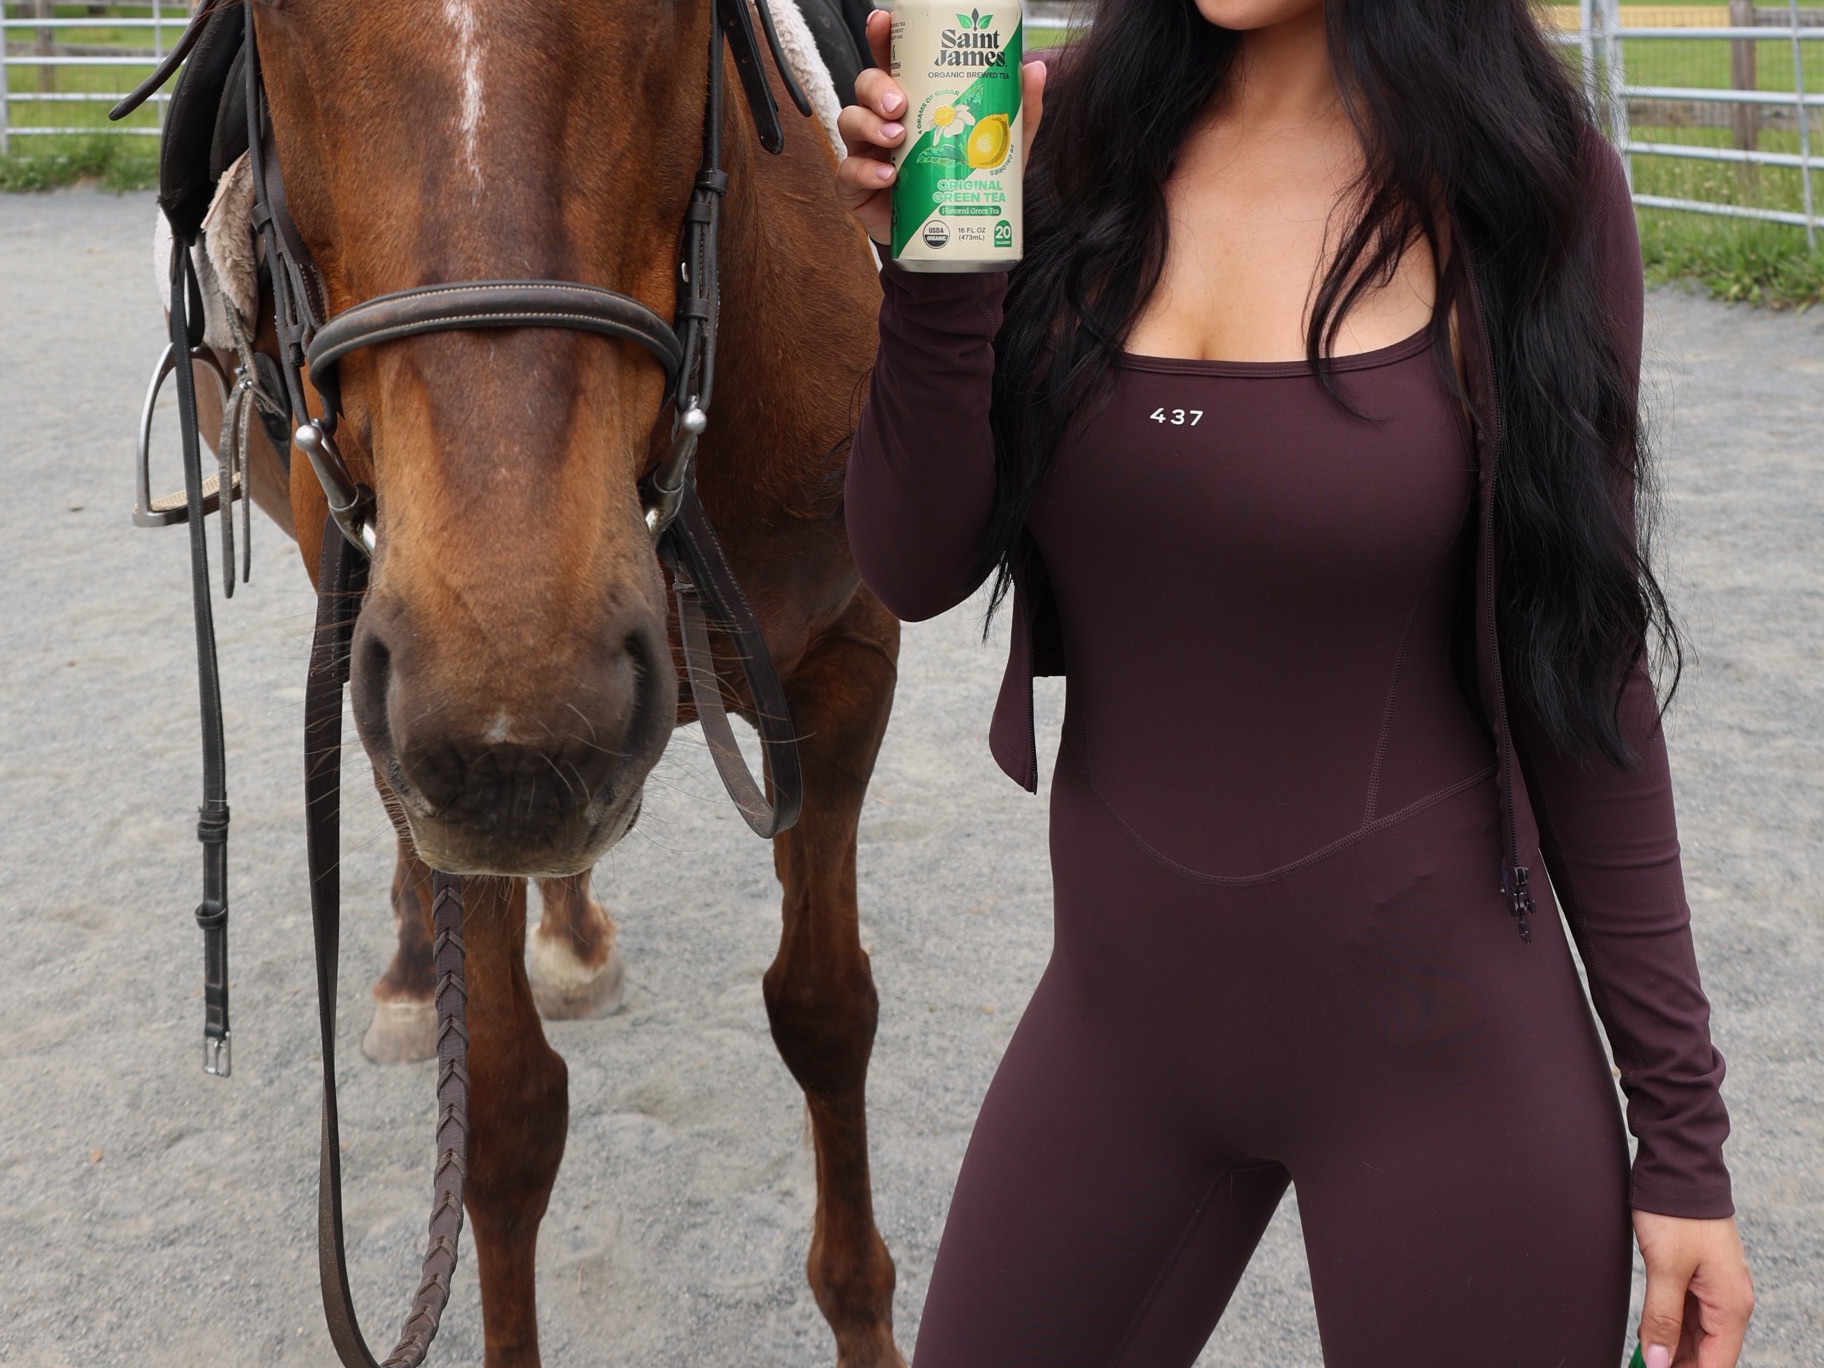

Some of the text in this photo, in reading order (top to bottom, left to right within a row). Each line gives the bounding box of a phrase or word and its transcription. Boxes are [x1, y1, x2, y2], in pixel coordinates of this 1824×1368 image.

[941, 29, 1000, 49] Saint
[934, 50, 1006, 67] James
[928, 71, 1009, 80] ORGANIC BREWED TEA
[917, 103, 927, 129] GRAMS
[925, 94, 933, 103] OF
[990, 154, 1012, 176] CALORIES
[937, 179, 1002, 191] ORIGINAL
[932, 191, 1006, 203] GREEN TEA
[942, 207, 969, 215] Flavored
[989, 207, 999, 215] Tea
[995, 226, 1011, 239] 20
[1149, 407, 1204, 426] 437
